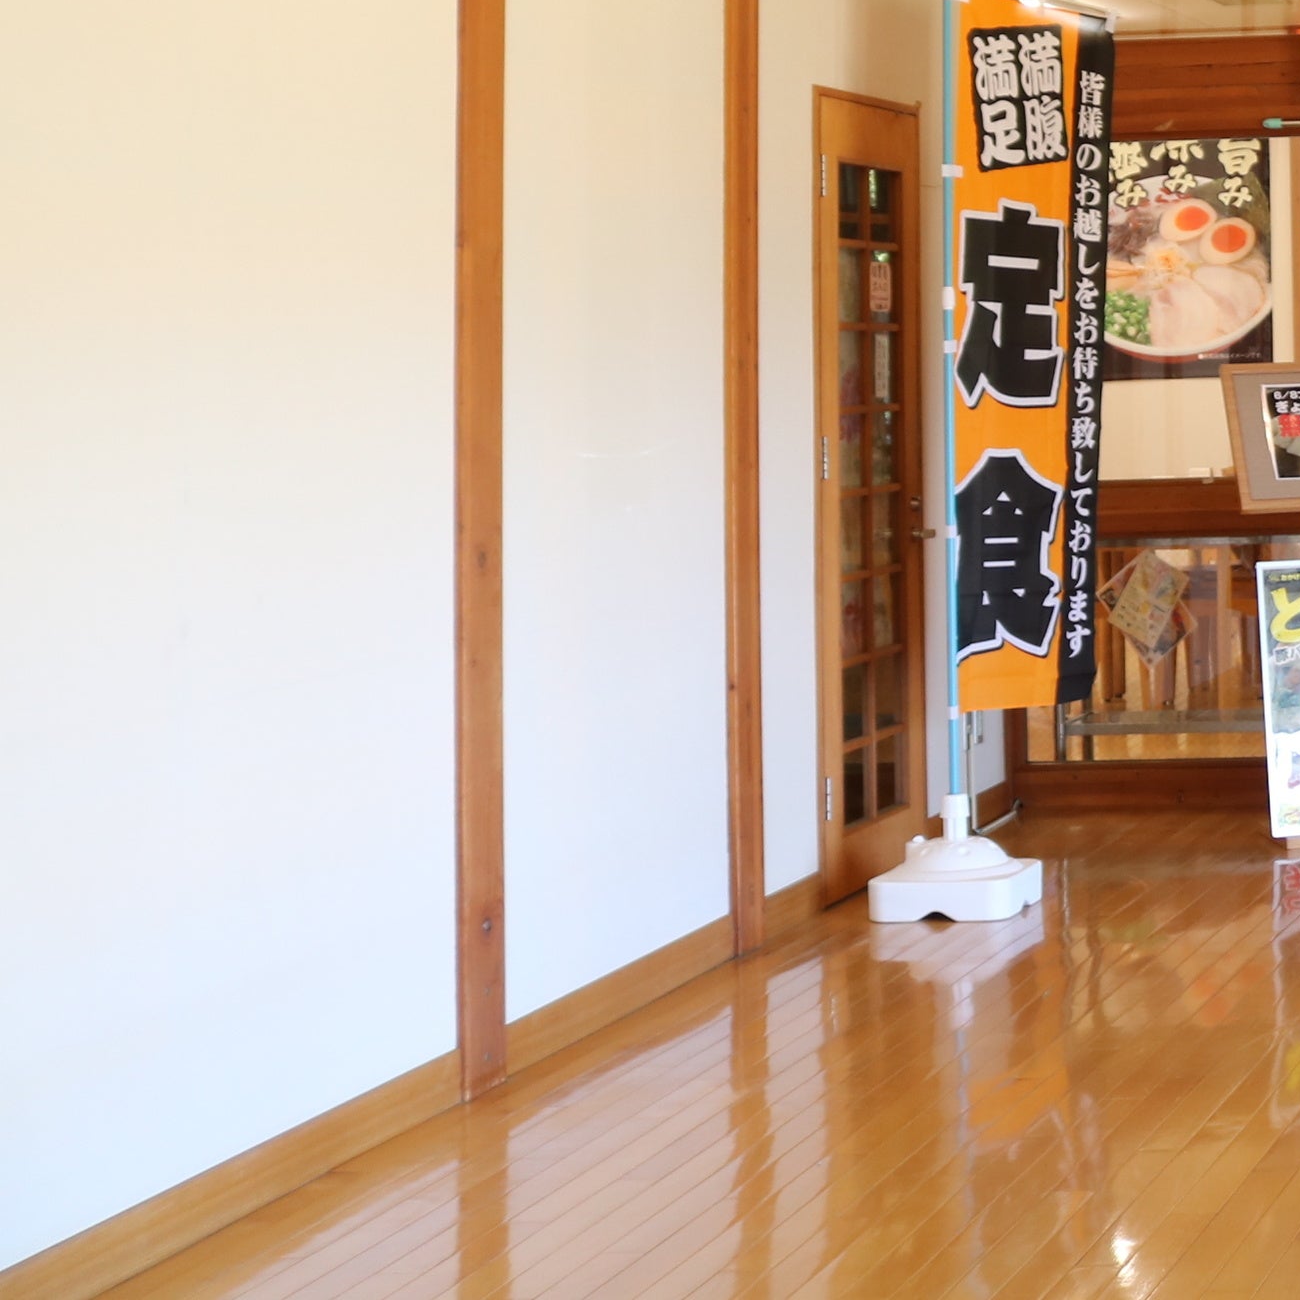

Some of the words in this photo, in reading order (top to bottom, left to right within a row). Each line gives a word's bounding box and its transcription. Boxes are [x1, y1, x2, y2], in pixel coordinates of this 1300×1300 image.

[954, 197, 1065, 665] 定食
[1066, 69, 1106, 659] 皆様のお越しをお待ち致しております
